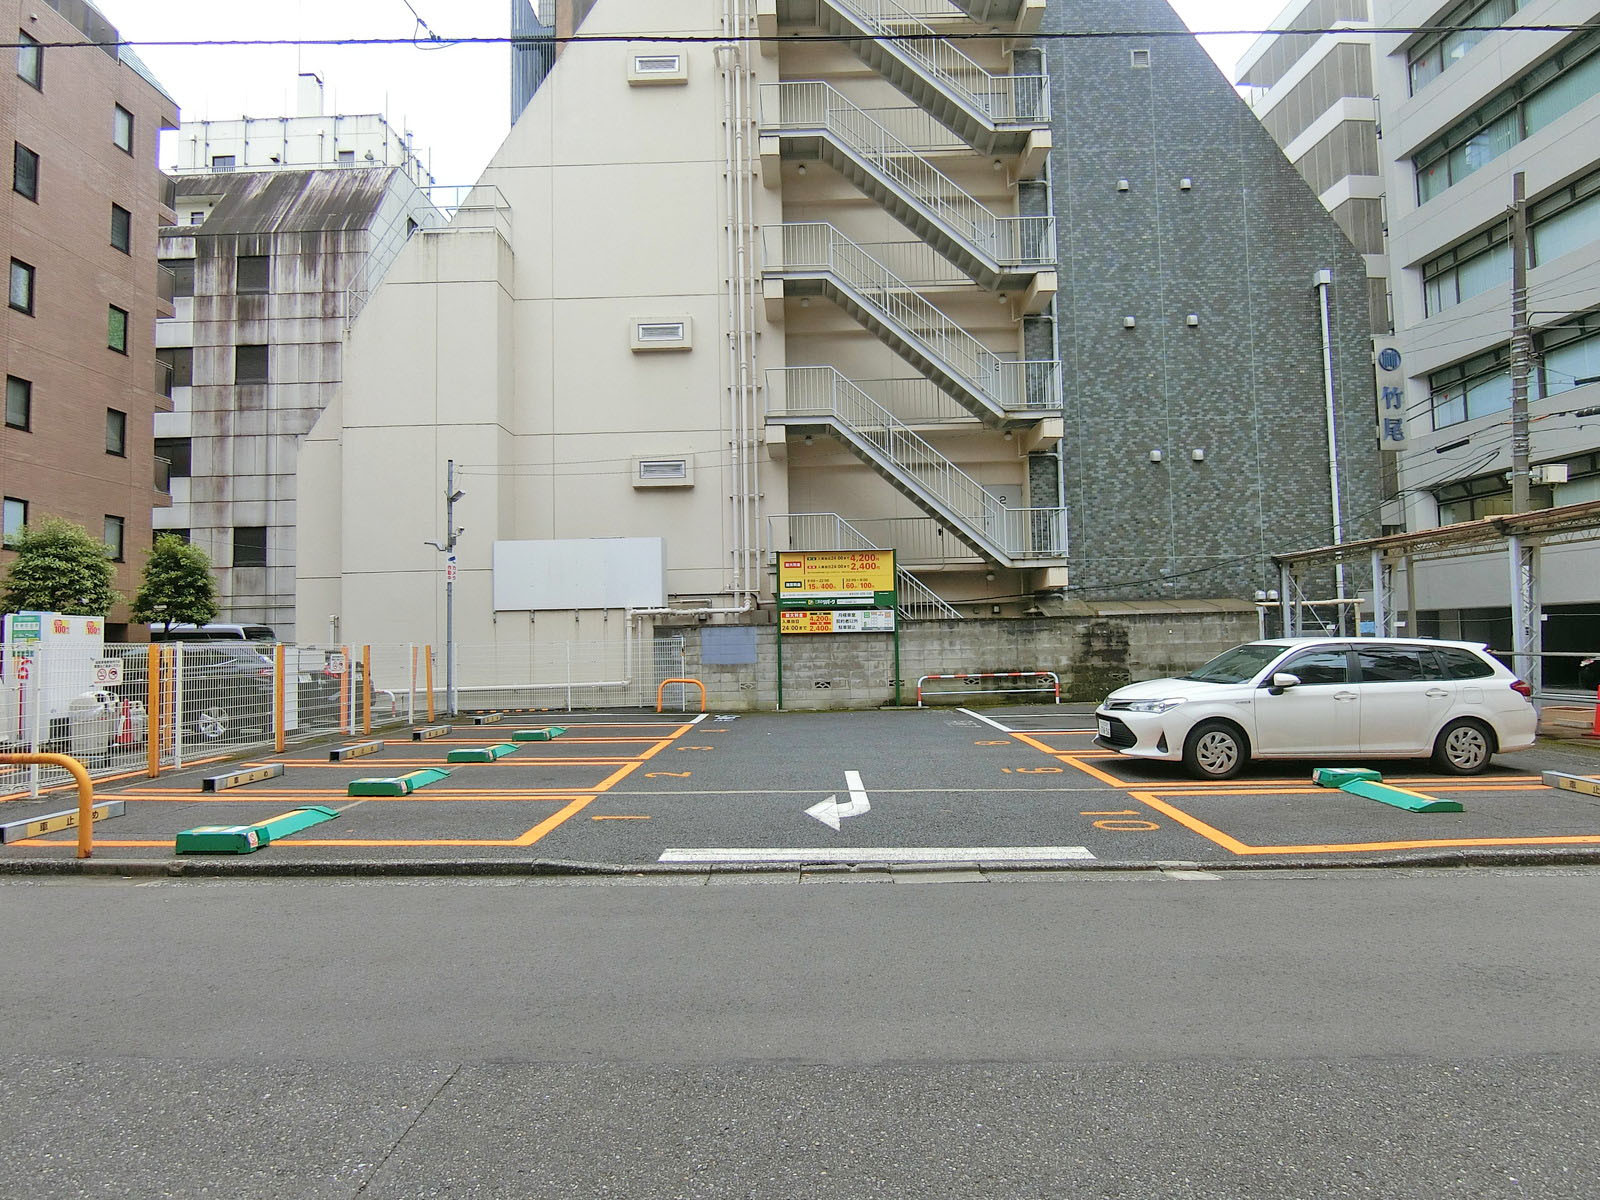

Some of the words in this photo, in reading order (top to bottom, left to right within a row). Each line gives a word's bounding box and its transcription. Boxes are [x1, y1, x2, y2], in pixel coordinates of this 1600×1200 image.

[1381, 386, 1405, 441] 竹尾
[999, 495, 1007, 505] 2
[1079, 809, 1161, 831] 10
